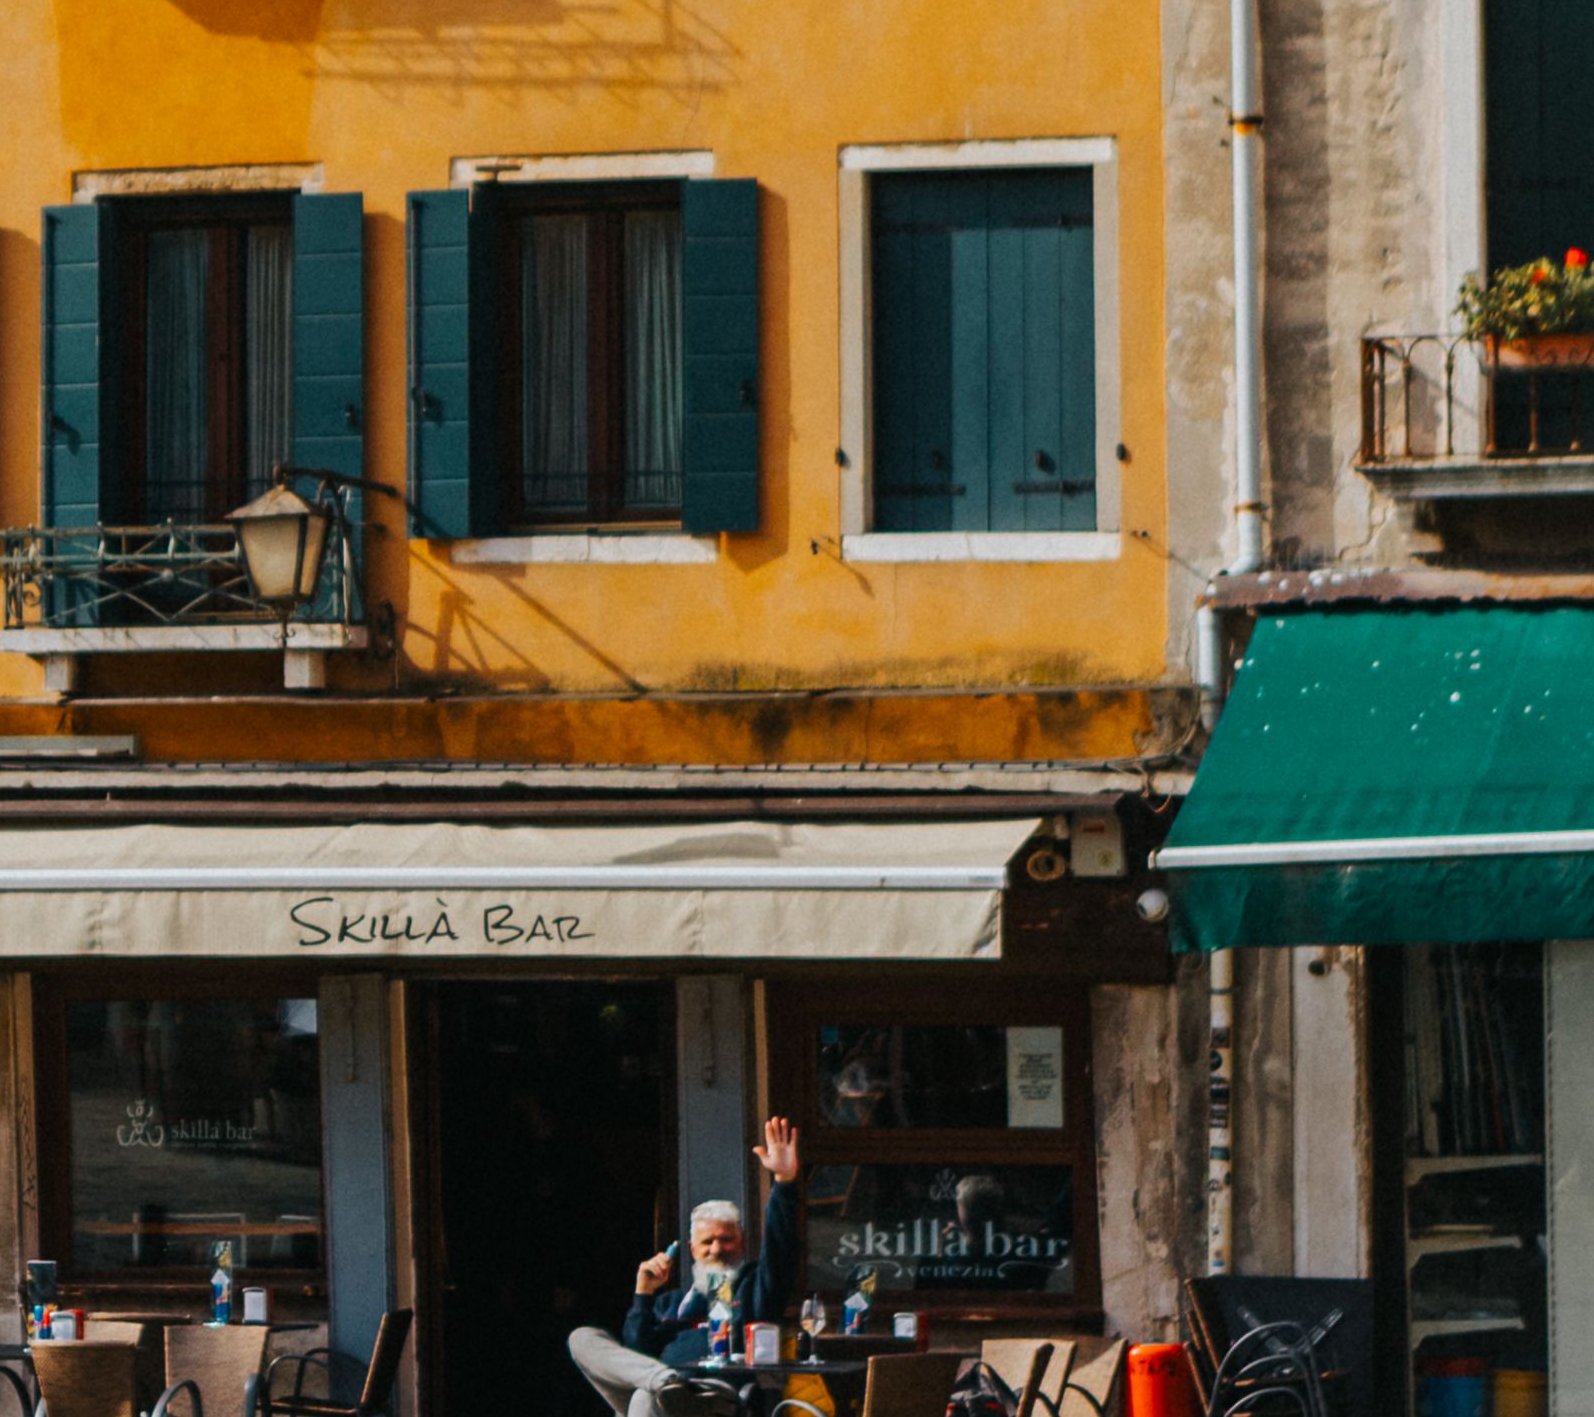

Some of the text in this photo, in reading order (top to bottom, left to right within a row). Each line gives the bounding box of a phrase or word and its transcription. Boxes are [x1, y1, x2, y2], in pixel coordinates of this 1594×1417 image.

[483, 904, 596, 946] BAR
[225, 1119, 257, 1140] bar
[984, 1219, 1069, 1257] bar
[906, 1263, 995, 1278] venezia
